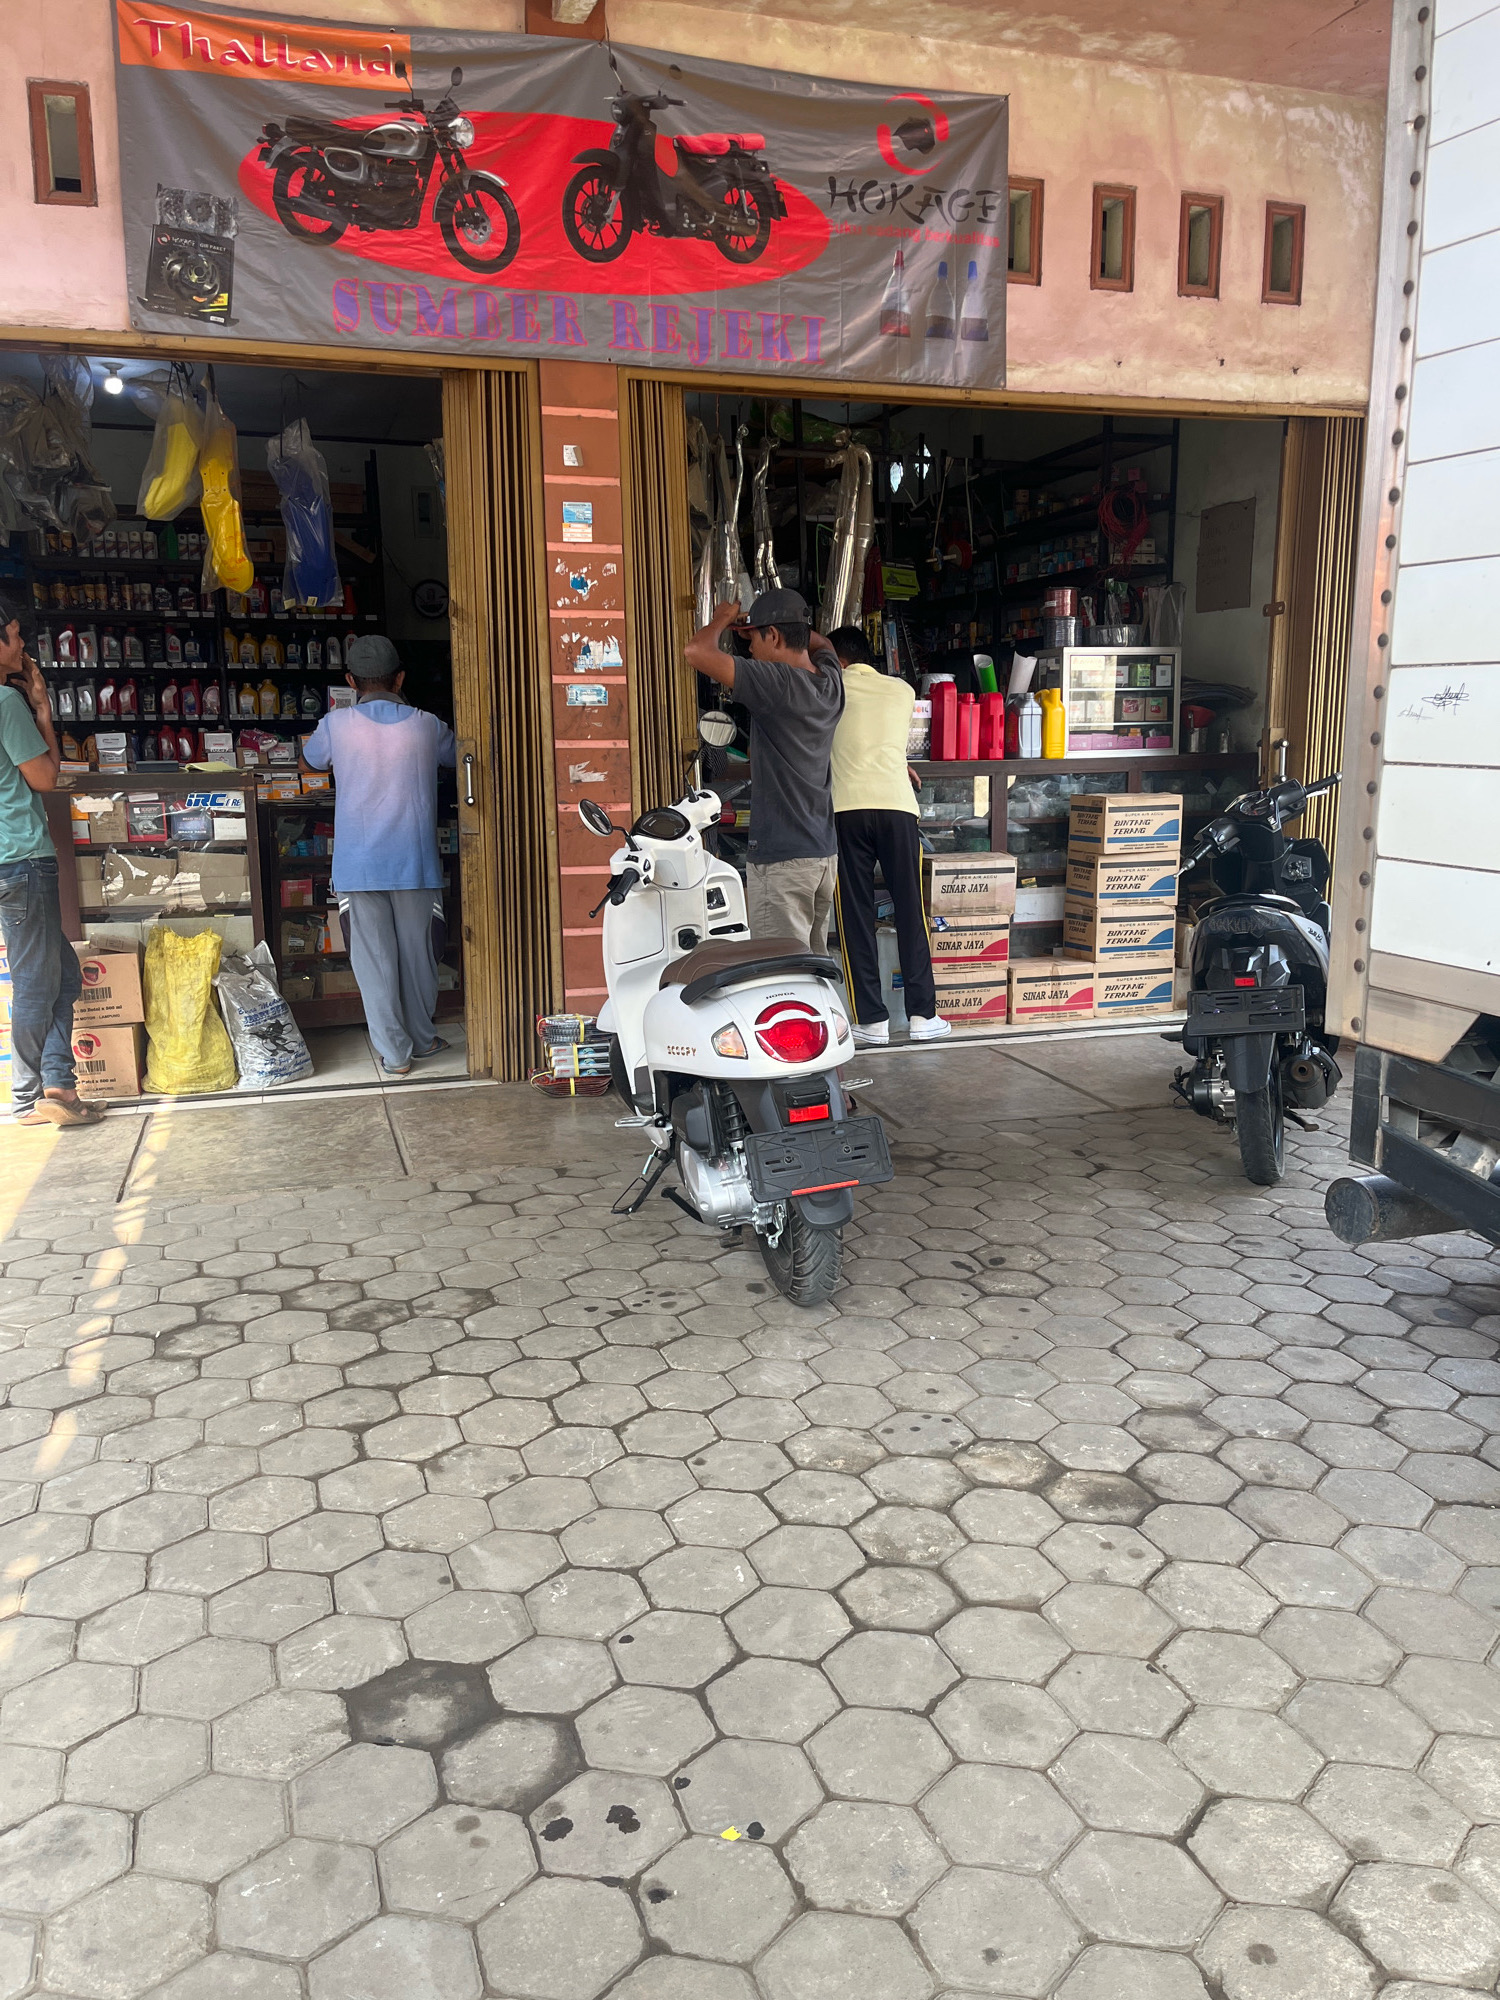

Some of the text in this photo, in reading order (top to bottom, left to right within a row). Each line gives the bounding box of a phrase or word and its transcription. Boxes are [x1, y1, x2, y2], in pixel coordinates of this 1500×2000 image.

[827, 175, 1001, 225] HOKAGE
[867, 226, 921, 243] cadang
[925, 226, 1000, 248] berkualitas
[332, 277, 826, 367] SUMBER REJEKI
[1114, 819, 1151, 827] BINTANG
[941, 884, 989, 894] SINAR JAYA
[1107, 929, 1147, 937] BINTANG
[936, 940, 985, 951] SINAR JAYA
[1106, 937, 1141, 945] TERANG
[1105, 983, 1144, 991] BINTANG
[1022, 989, 1069, 1001] SINAR JAYA
[1104, 991, 1139, 999] TERANG
[935, 997, 983, 1009] SINAR JAYA
[667, 1045, 697, 1056] SCOOPY
